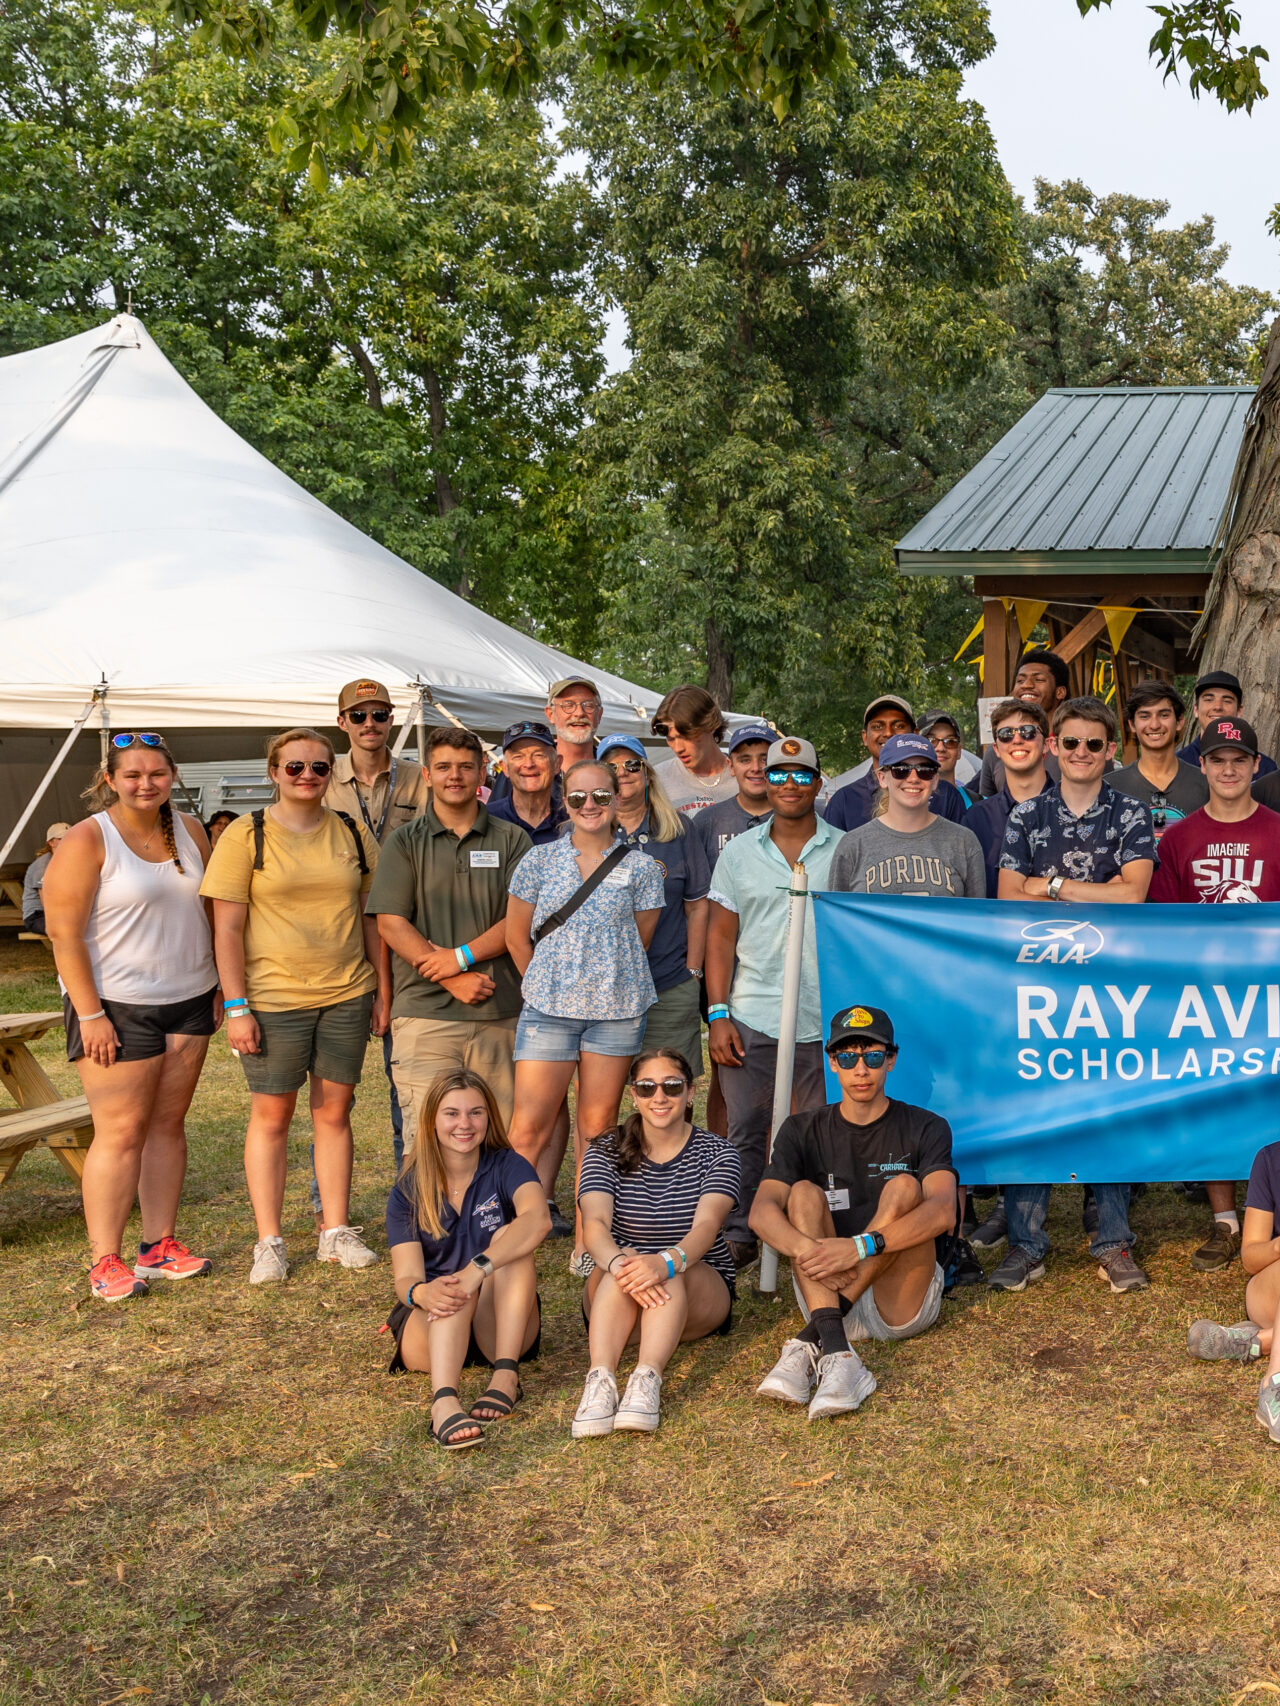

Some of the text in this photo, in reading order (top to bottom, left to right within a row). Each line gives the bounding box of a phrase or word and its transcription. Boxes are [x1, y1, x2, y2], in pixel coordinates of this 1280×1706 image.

[1218, 723, 1241, 740] PN
[1016, 943, 1085, 964] EAA
[1017, 985, 1151, 1039] RAY
